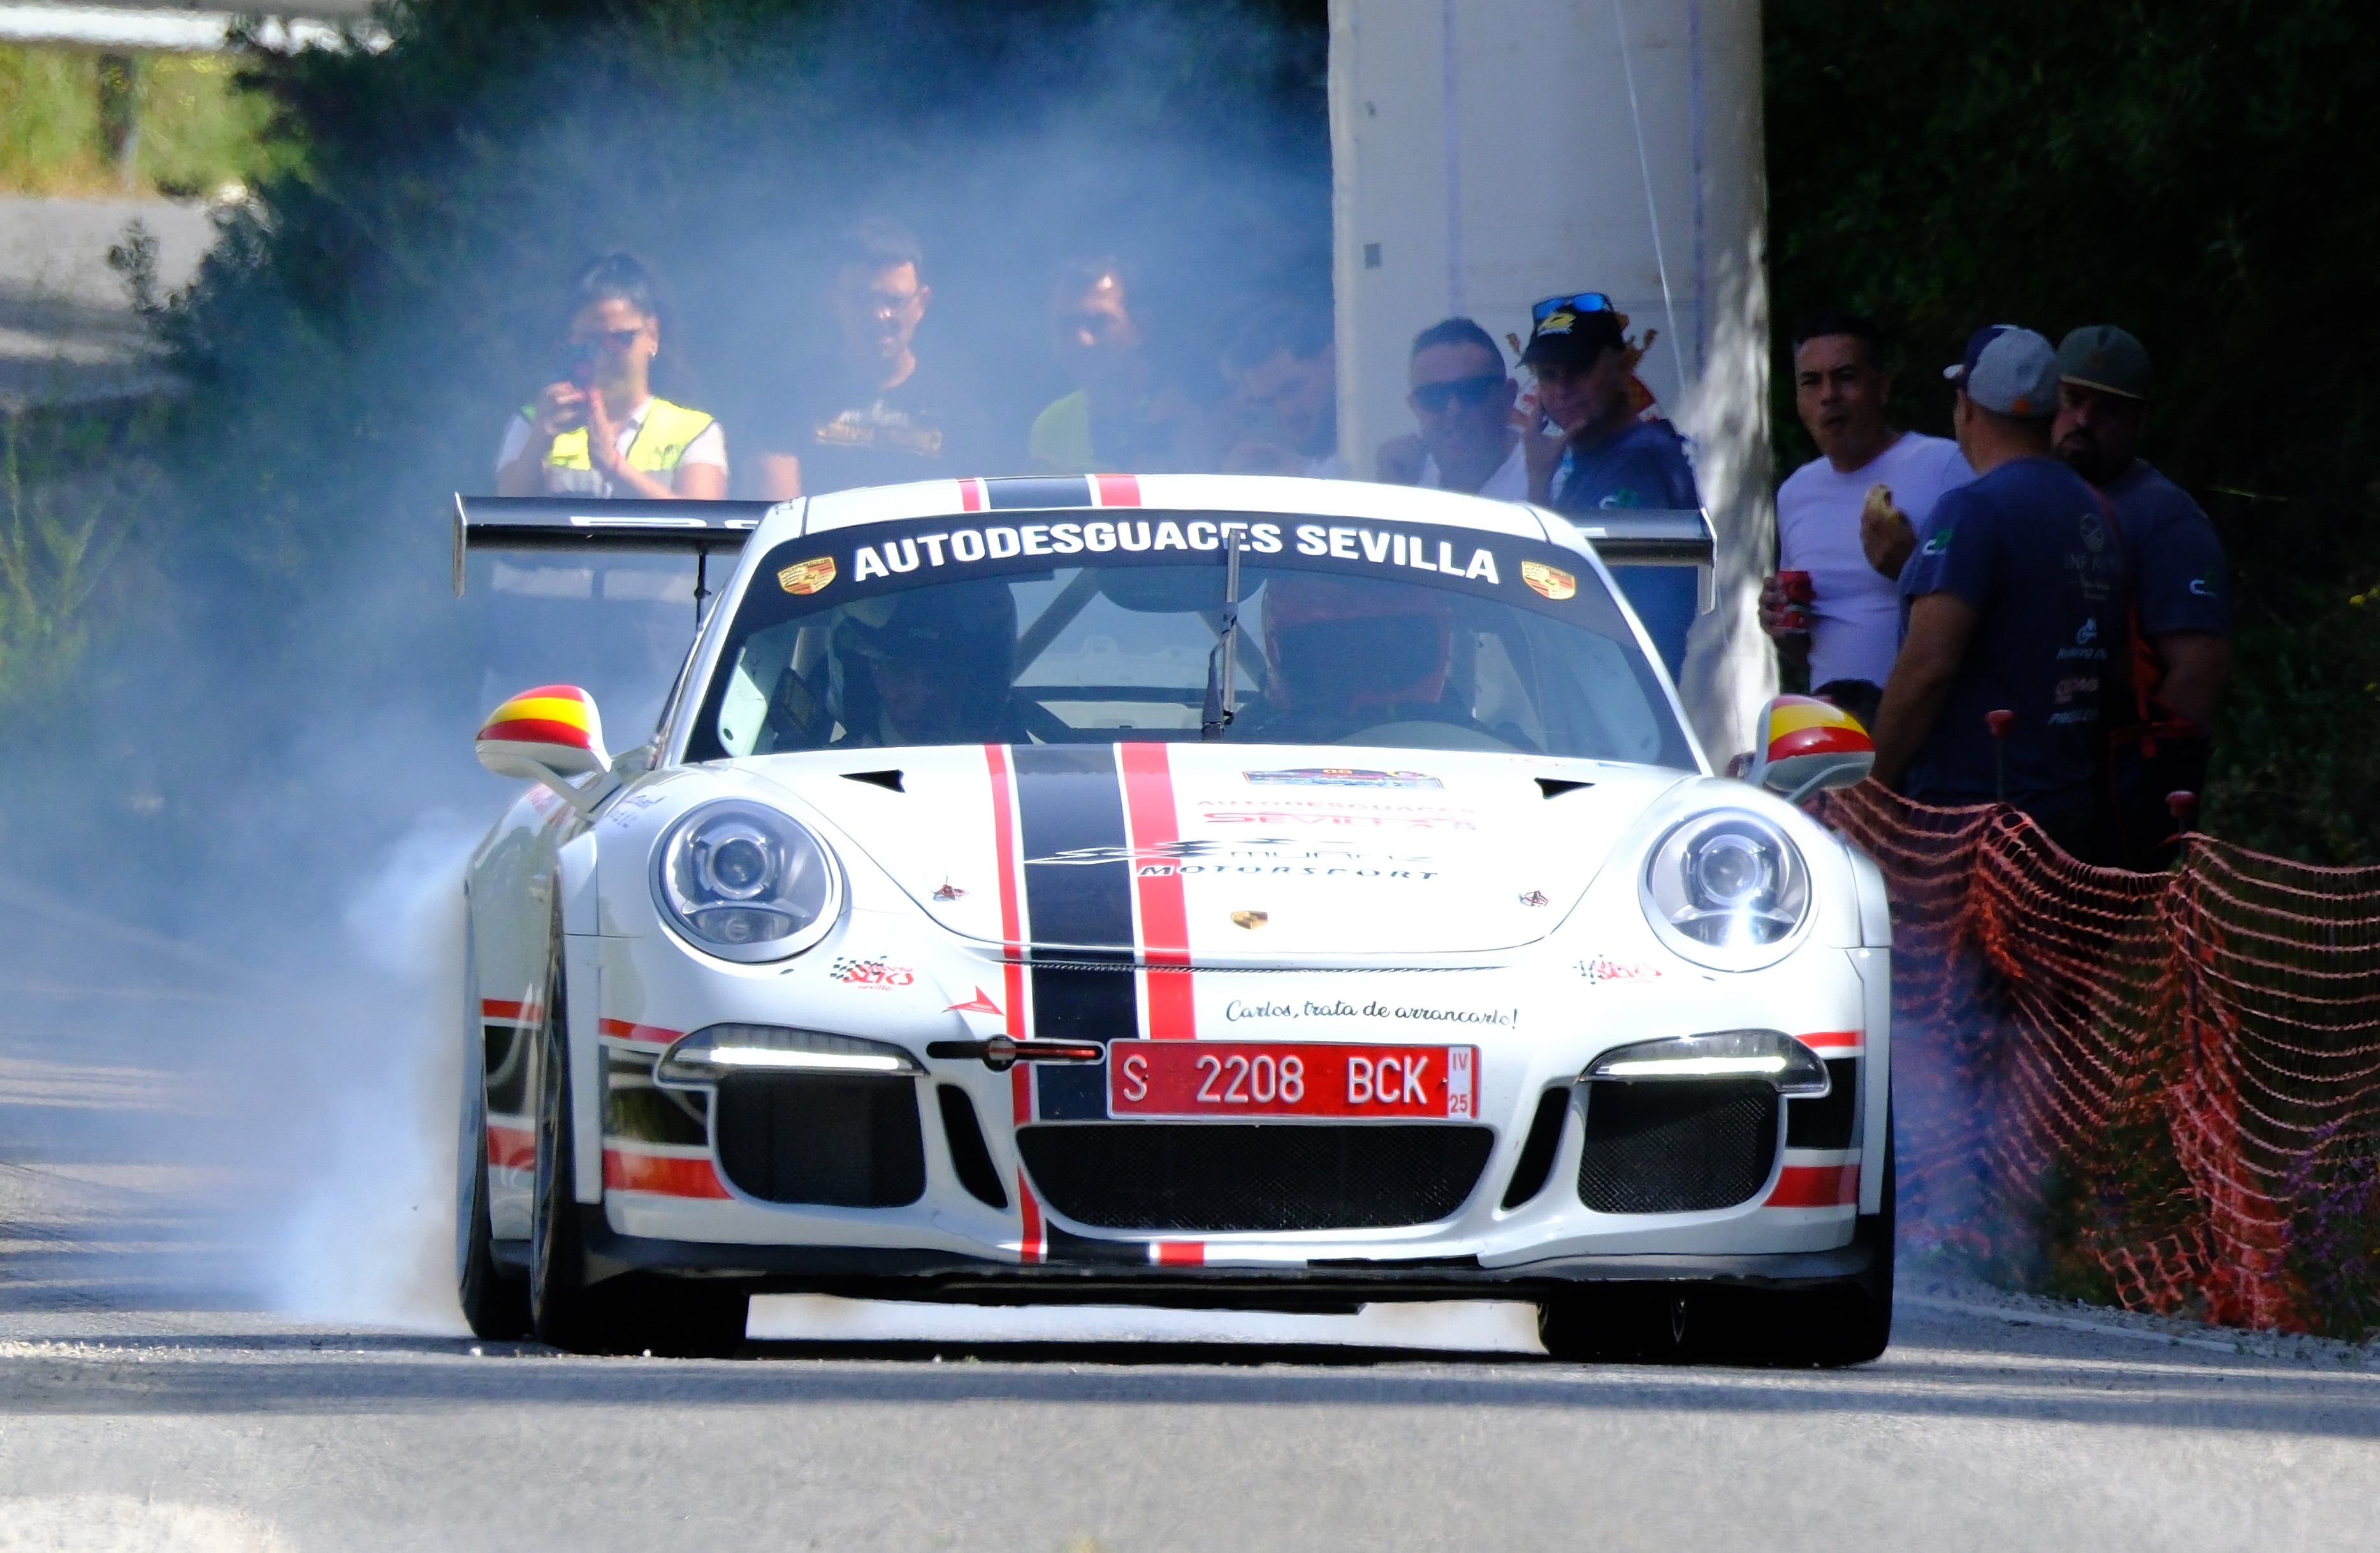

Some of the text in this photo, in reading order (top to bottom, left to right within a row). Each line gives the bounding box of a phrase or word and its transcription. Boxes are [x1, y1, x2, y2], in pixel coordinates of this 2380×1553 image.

[853, 520, 1501, 585] AUTODESGUACES SEVILLA
[1138, 865, 1439, 880] MOTORSPORT
[1226, 1000, 1518, 1030] Carlos, trata de arrancarlo!
[1452, 1053, 1469, 1072] IV
[1123, 1054, 1429, 1104] S 2208 BCK
[1449, 1094, 1469, 1114] 25
